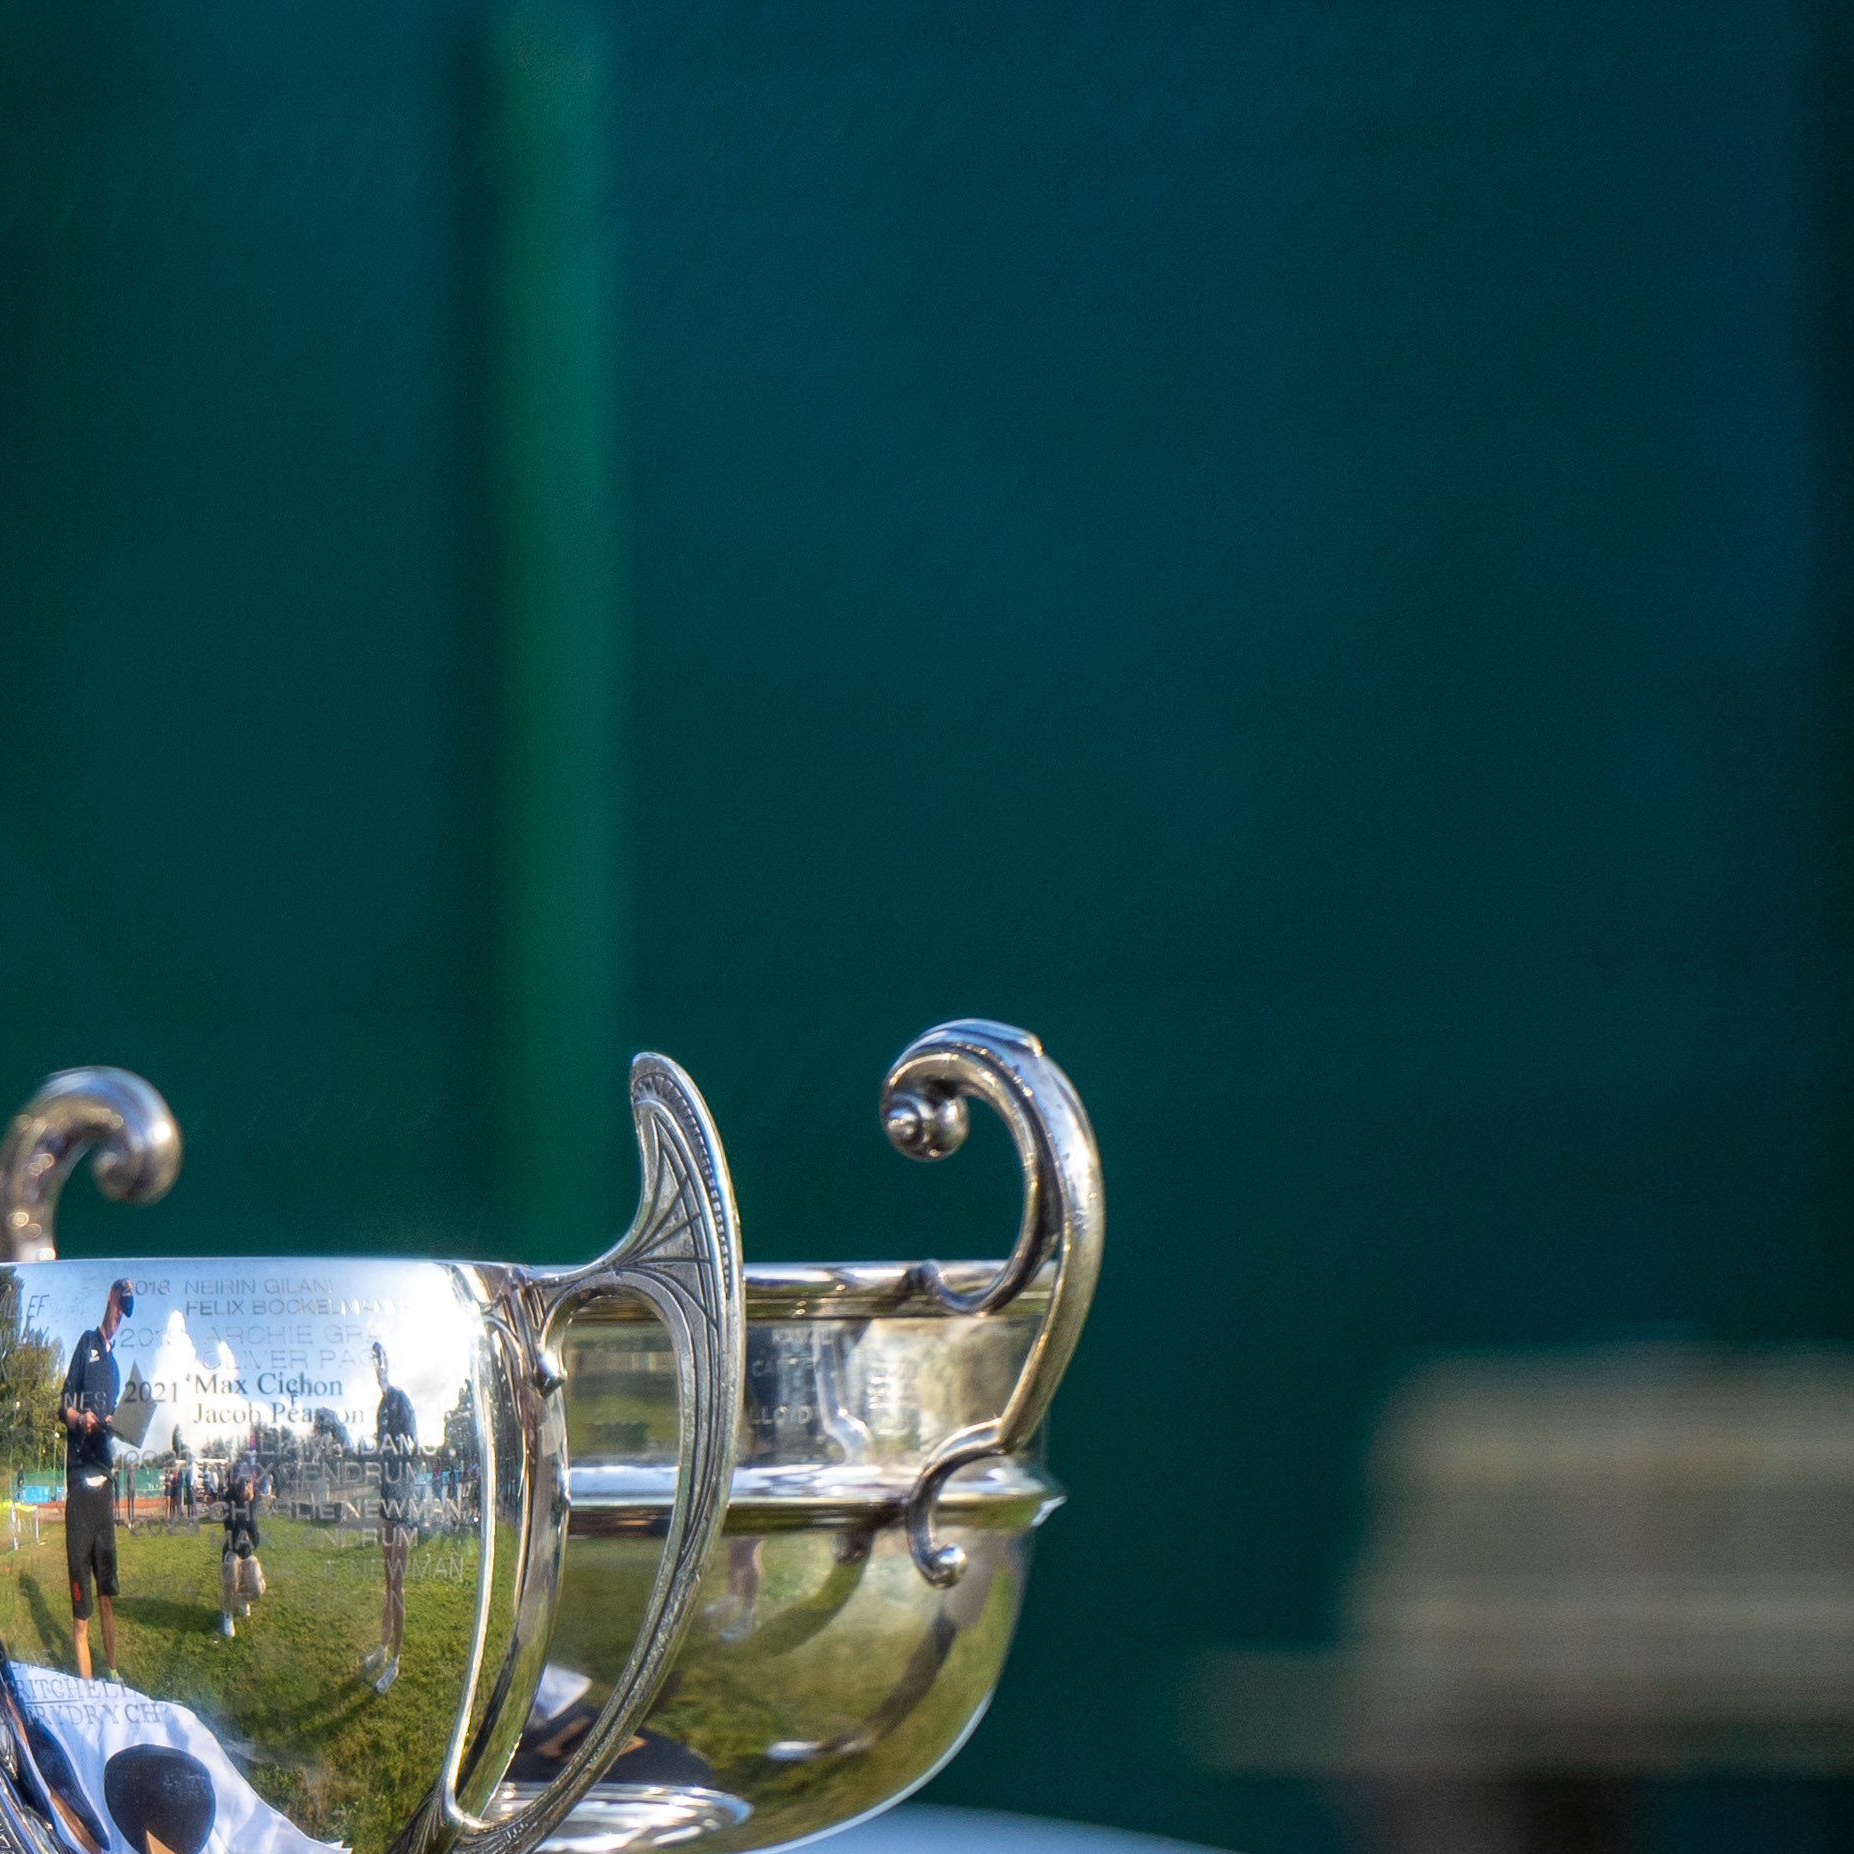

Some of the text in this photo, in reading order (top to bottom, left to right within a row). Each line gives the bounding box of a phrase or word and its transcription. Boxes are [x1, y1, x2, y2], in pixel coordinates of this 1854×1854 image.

[184, 1279, 256, 1295] NEIRIN
[263, 1278, 333, 1295] GILANI
[186, 1300, 245, 1316] FELIX
[124, 1380, 178, 1402] 2021
[194, 1373, 250, 1396] Max
[193, 1402, 365, 1425] Jacob Peaon
